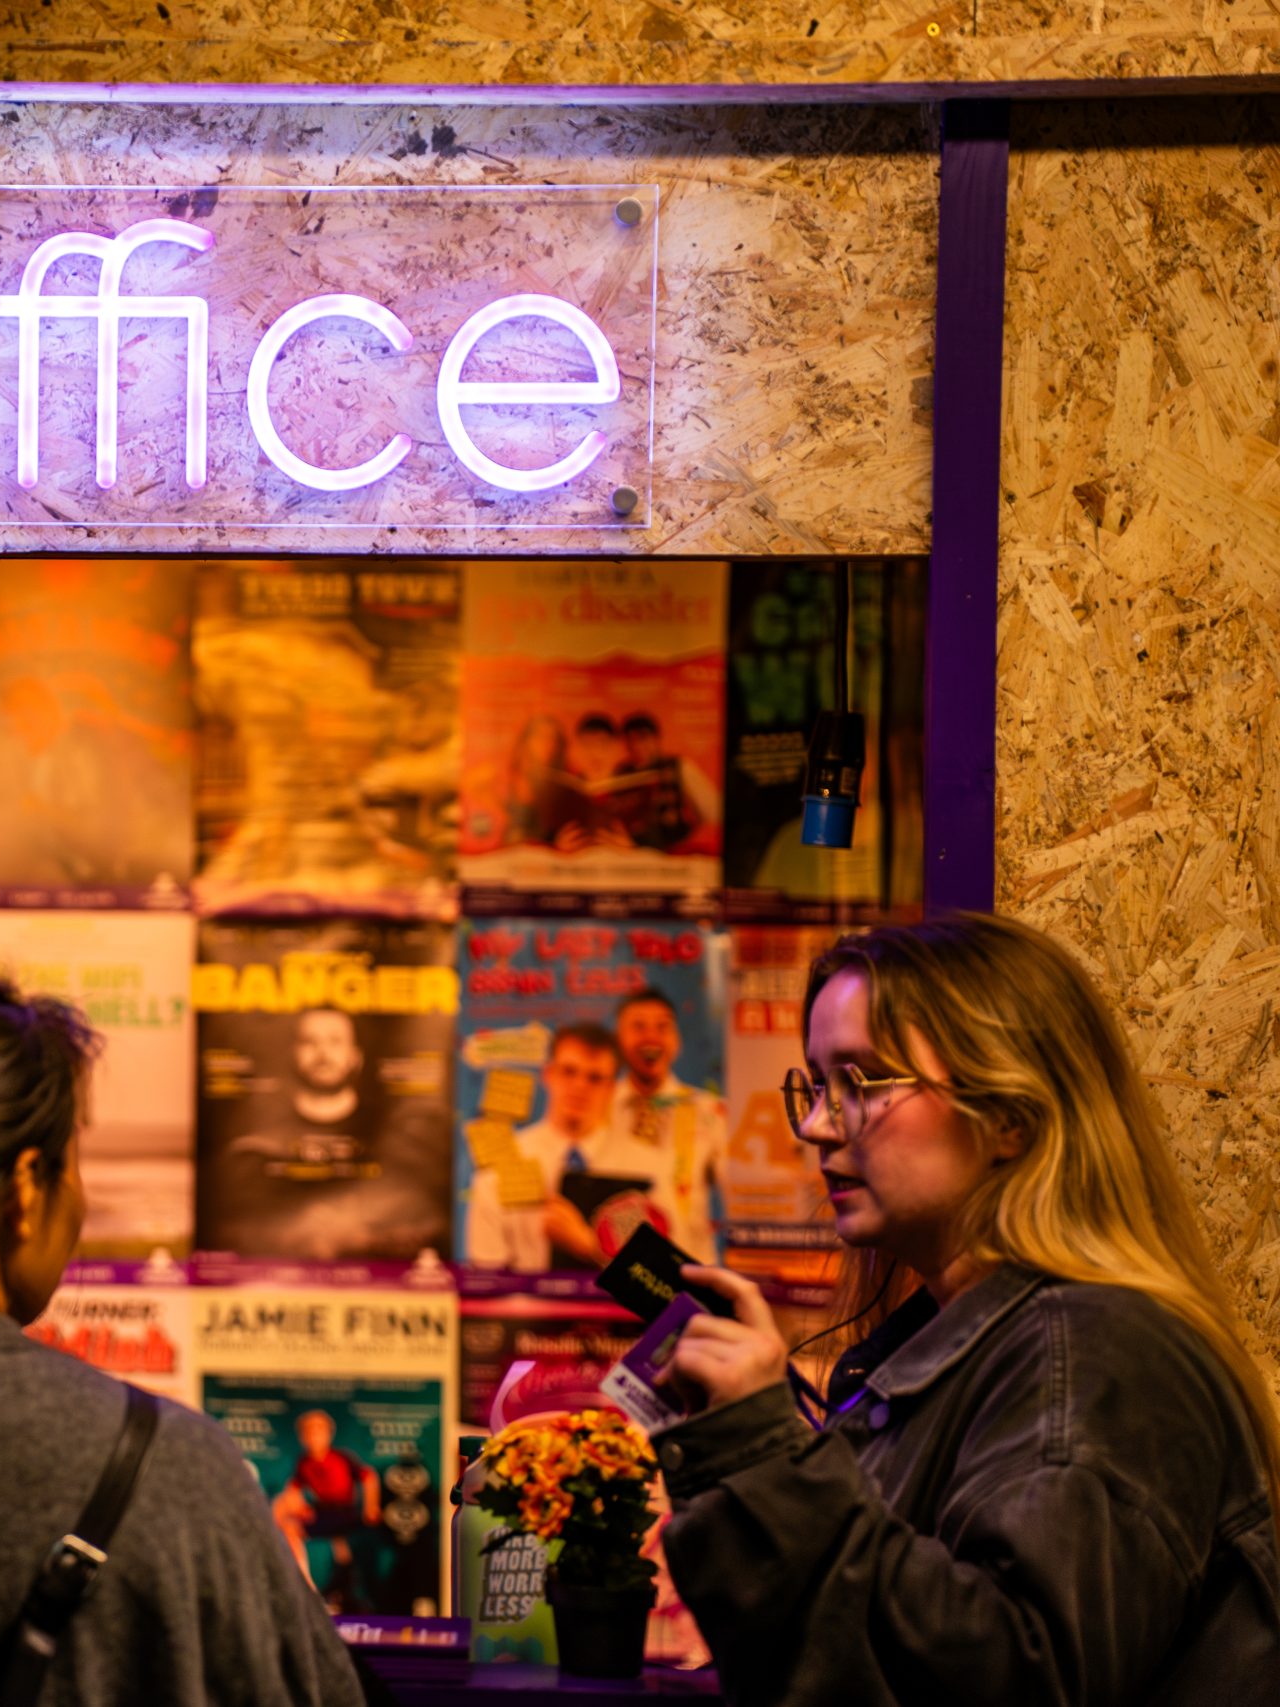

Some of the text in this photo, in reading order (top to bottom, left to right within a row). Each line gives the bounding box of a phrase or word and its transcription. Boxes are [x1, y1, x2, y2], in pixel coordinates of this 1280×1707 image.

[192, 962, 458, 1012] BANGER
[201, 1305, 448, 1337] JAMIE FINN
[490, 1549, 548, 1572] MORE
[488, 1572, 543, 1594] WORR
[484, 1594, 535, 1617] LESS
